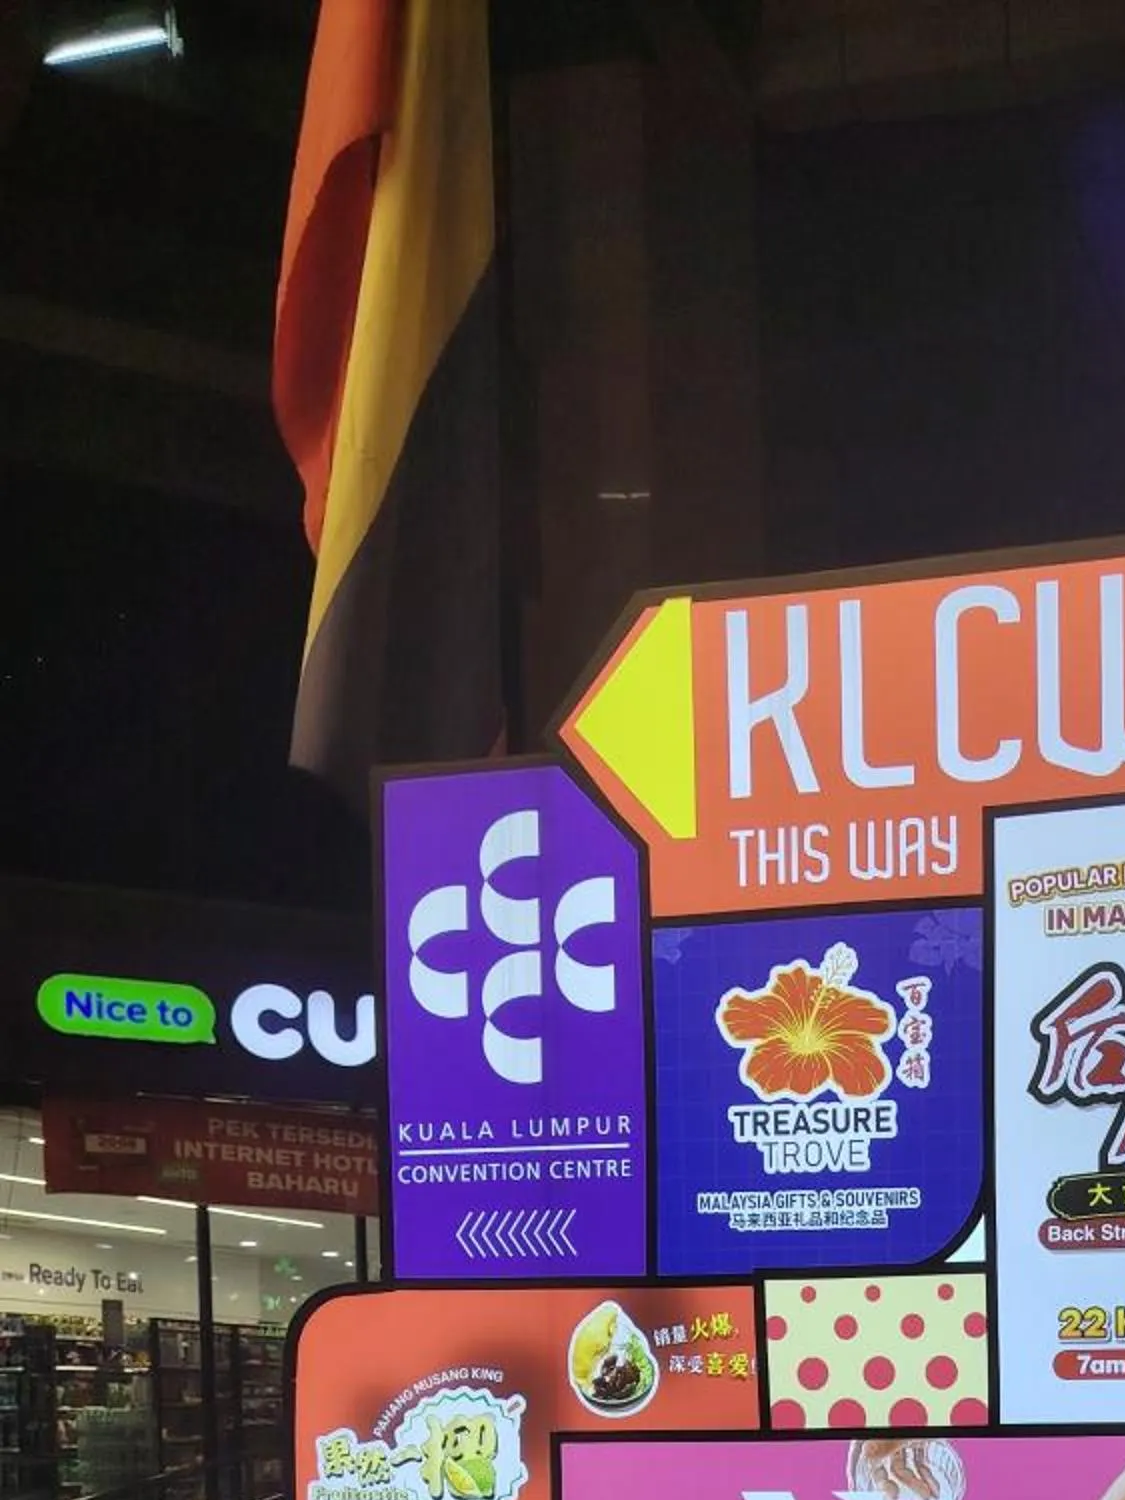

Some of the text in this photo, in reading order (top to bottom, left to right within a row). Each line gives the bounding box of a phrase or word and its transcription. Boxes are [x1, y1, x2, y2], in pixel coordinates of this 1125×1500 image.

[729, 815, 958, 888] THIS WAY
[1009, 867, 1118, 902] POPULAR
[1047, 907, 1076, 931] IN
[65, 990, 194, 1027] Nice to
[231, 984, 377, 1067] CU
[208, 1117, 378, 1152] PEK TERSEDI
[398, 1115, 632, 1143] KUALA LUMPUR
[734, 1105, 893, 1137] TREASURE
[174, 1139, 305, 1168] INTERNET
[763, 1138, 867, 1169] TROVE
[248, 1171, 359, 1199] BAHARU
[397, 1159, 632, 1185] CONVENTION CENTRE
[699, 1189, 920, 1211] MALAYSIA GIFTS & SOUVENIRS
[1047, 1225, 1096, 1243] Back
[29, 1262, 87, 1293] Ready
[91, 1268, 112, 1291] To
[1057, 1306, 1108, 1341] 22
[372, 1367, 504, 1438] PAHANG MUSANG KING
